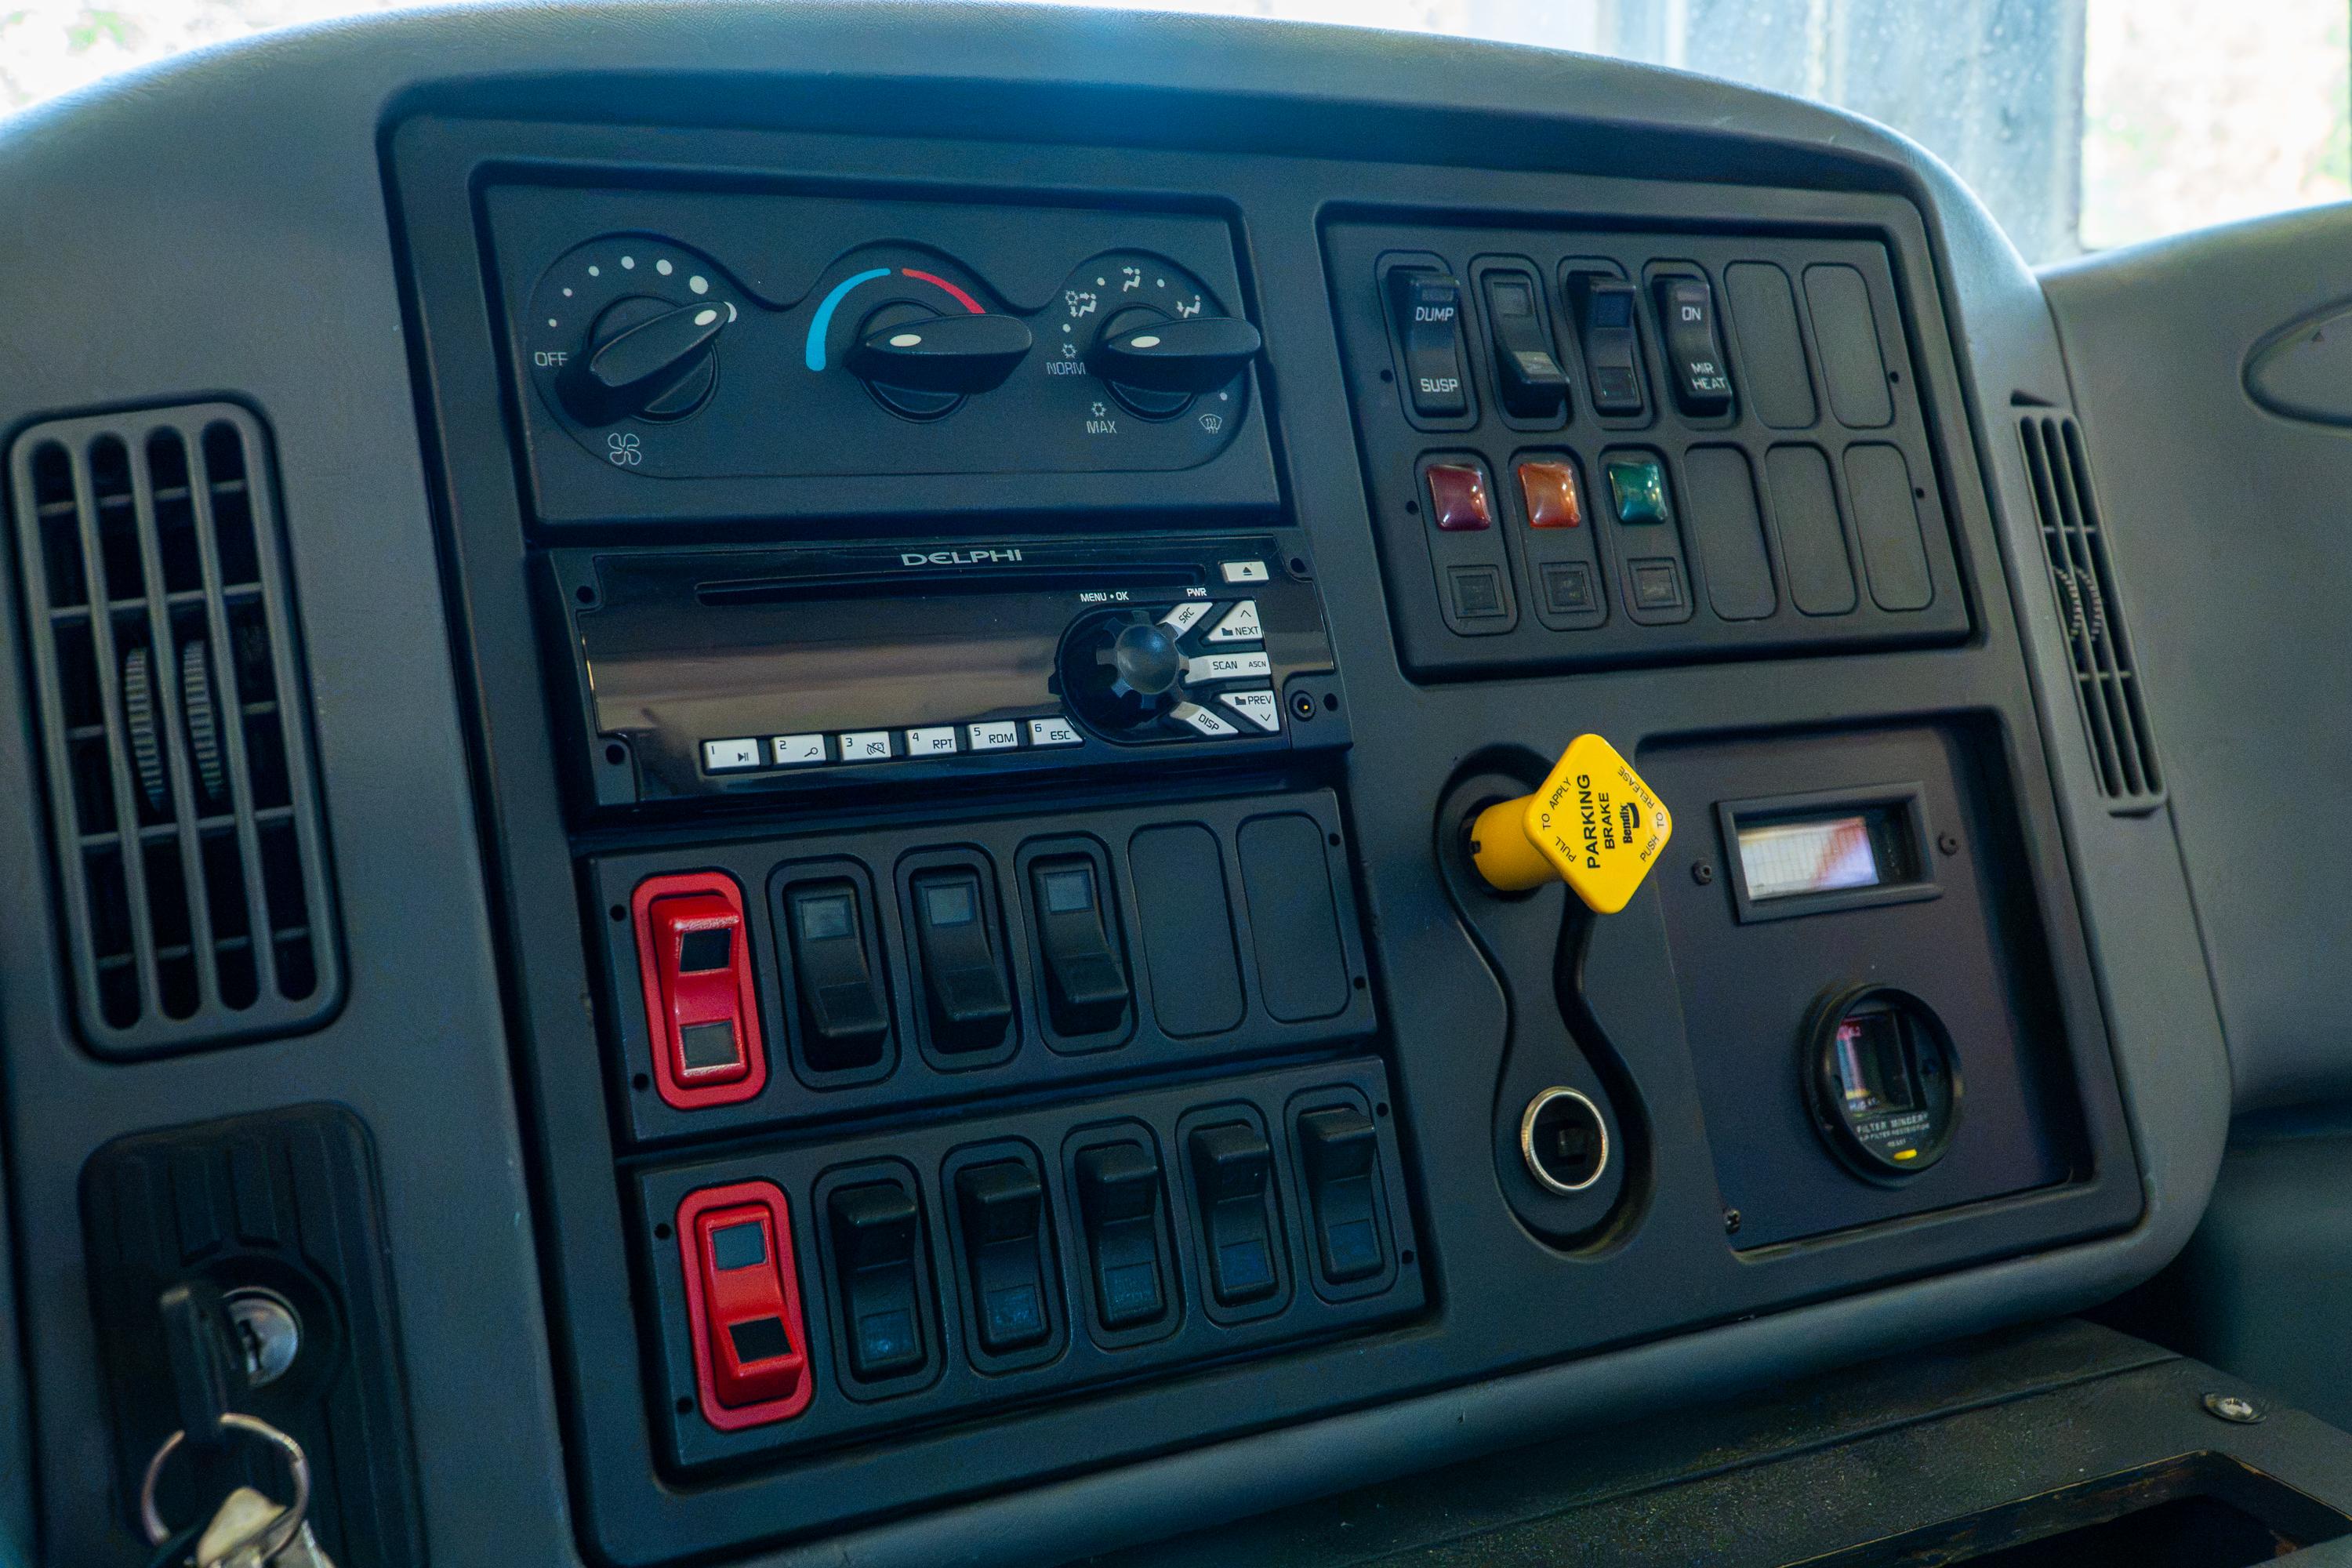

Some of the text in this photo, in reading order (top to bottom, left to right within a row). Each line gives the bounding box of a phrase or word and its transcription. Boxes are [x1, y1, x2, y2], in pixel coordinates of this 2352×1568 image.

[1415, 307, 1454, 321] DUMP
[1682, 307, 1702, 321] ON
[534, 351, 568, 366] OFF
[1046, 361, 1087, 376] NORM
[1690, 361, 1715, 375] MIR
[1420, 378, 1458, 393] SUSP
[1691, 376, 1727, 390] HEAT
[1086, 420, 1117, 434] MAX
[900, 550, 1022, 566] DELPHI
[1080, 590, 1130, 602] MENU OK
[1186, 587, 1207, 597] PWR
[1178, 607, 1195, 624] SRC
[1235, 626, 1259, 636] NEXT
[1212, 660, 1238, 670] SCAN
[1247, 695, 1272, 705] PREV
[1034, 723, 1042, 732] 6
[1198, 713, 1220, 731] DISP
[912, 732, 920, 742] 4
[973, 727, 981, 736] 5
[989, 732, 1014, 744] RDM
[1051, 730, 1071, 740] ESC
[779, 740, 787, 750] 2
[845, 737, 853, 747] 3
[932, 738, 953, 750] RPT
[710, 746, 715, 755] 1
[1541, 776, 1577, 862] PULL TO APPLY
[1617, 765, 1664, 862] PUSH TO RELEASE
[1577, 774, 1601, 869] PARKING
[1599, 792, 1616, 850] BRAKE
[1620, 803, 1633, 844] Bendix
